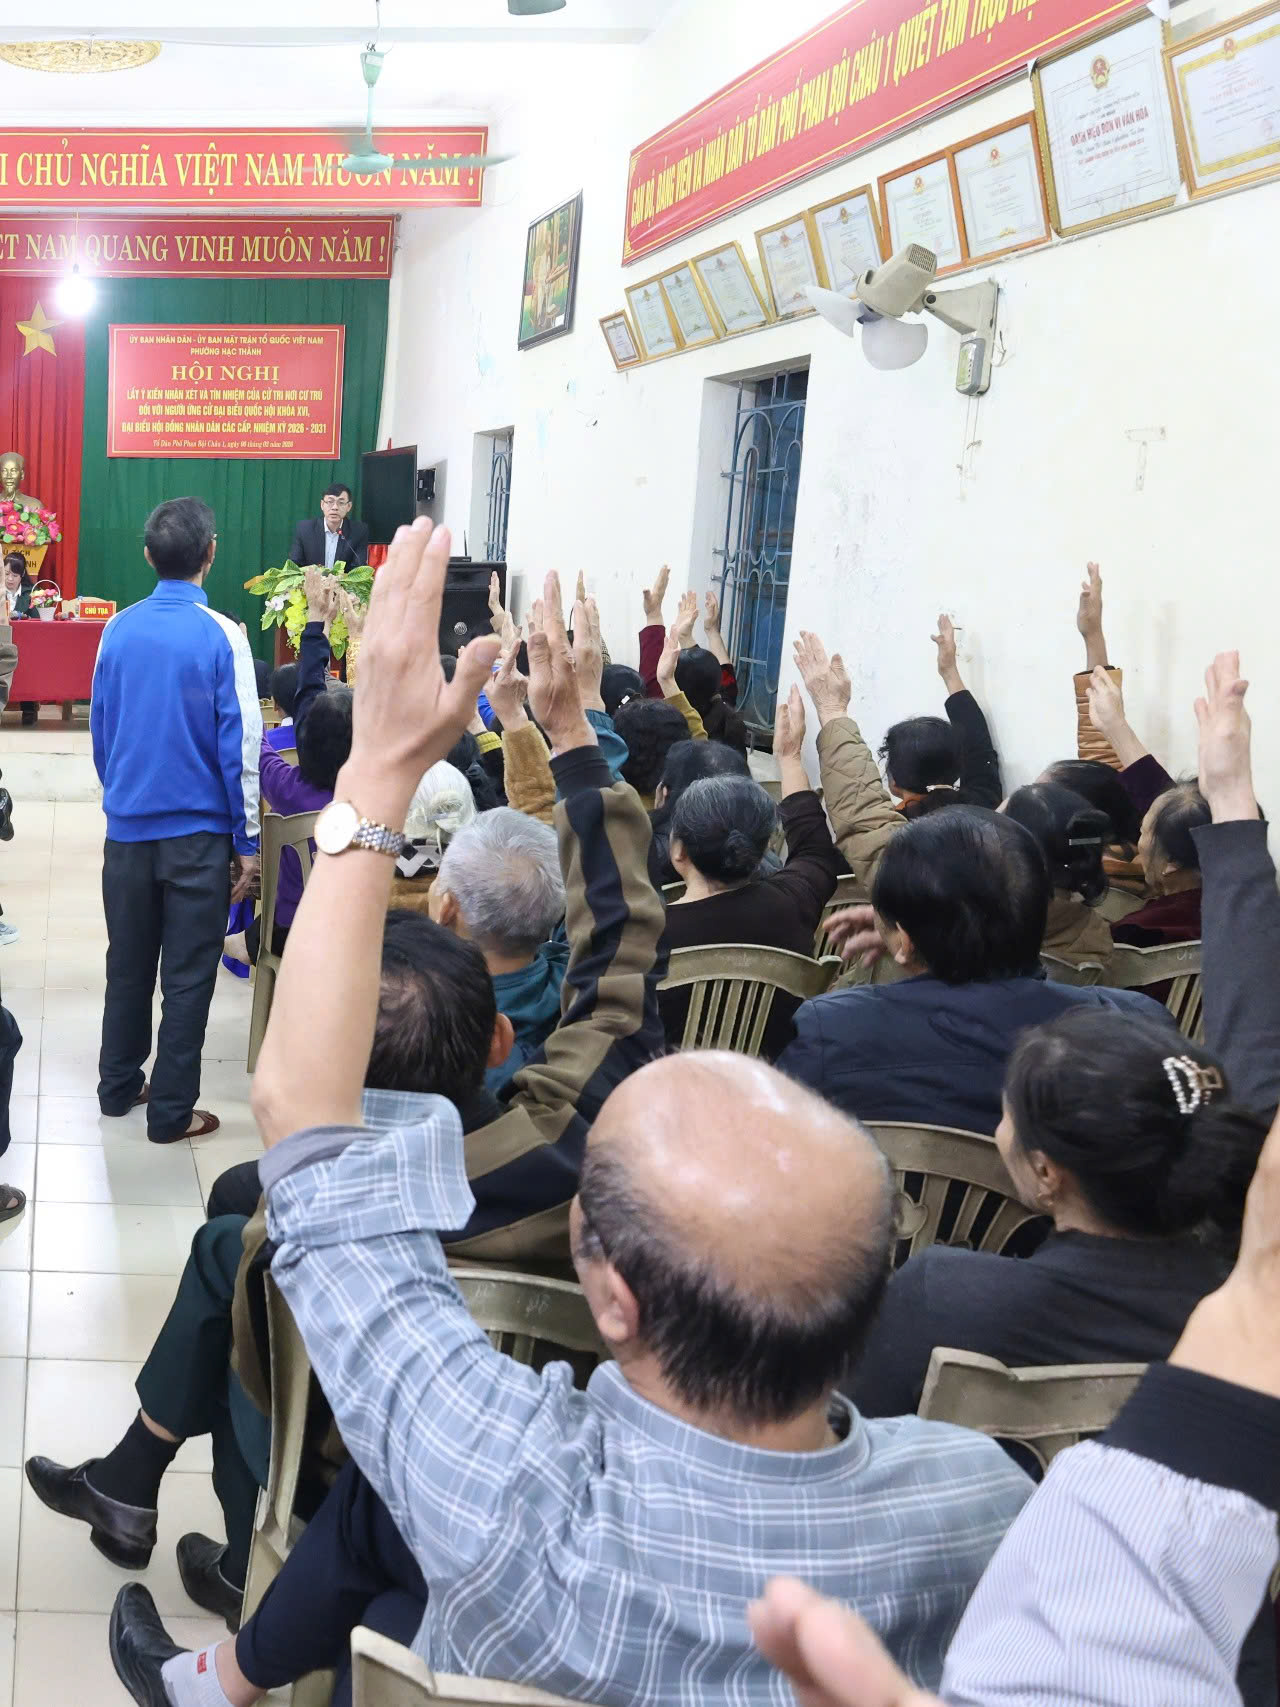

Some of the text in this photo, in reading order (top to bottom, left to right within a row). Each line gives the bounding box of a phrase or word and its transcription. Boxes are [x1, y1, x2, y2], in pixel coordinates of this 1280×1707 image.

[799, 68, 830, 134] PHAN
[828, 47, 851, 126] BỘI
[849, 29, 885, 106] CHÂU
[883, 31, 894, 88] 1
[16, 138, 73, 187] CHỦ
[80, 144, 168, 187] NGHĨA
[174, 142, 238, 196] VIỆT
[244, 153, 304, 187] NAM
[400, 143, 462, 187] NĂM
[26, 233, 77, 261] NAM
[84, 235, 169, 266] QUANG
[174, 235, 234, 262] VINH
[241, 228, 313, 263] MUÔN
[318, 228, 374, 263] NĂM
[140, 336, 154, 344] BAN
[156, 334, 176, 344] NHÂN
[177, 334, 192, 344] DÂN
[208, 336, 222, 344] BAN
[224, 335, 238, 346] MẶT
[240, 335, 257, 346] TRẬN
[259, 333, 268, 344] TỔ
[269, 334, 290, 344] QUỐC
[292, 335, 307, 346] VIỆT
[308, 336, 324, 344] NAM
[191, 346, 262, 357] PHƯỜNG HẠC THÀNH
[171, 360, 280, 385] HỘI NGHỊ
[127, 386, 140, 400] LẤY
[147, 387, 163, 400] KIẾN
[164, 388, 184, 402] NHẬN
[185, 388, 198, 400] XÉT
[199, 388, 208, 400] VÀ
[210, 388, 221, 400] TÍN
[223, 388, 245, 401] NHIỆM
[246, 387, 260, 400] CỦA
[262, 387, 273, 400] CỬ
[273, 390, 284, 400] TRI
[285, 389, 297, 400] NƠI
[299, 389, 309, 400] CƯ
[310, 388, 323, 400] TRÚ
[138, 402, 151, 416] ĐỐI
[152, 403, 163, 416] VỚI
[164, 403, 186, 416] NGƯỜI
[187, 403, 202, 416] ỨNG
[203, 402, 213, 416] CỬ
[213, 405, 225, 418] ĐẠI
[227, 401, 243, 416] BIỂU
[244, 402, 263, 417] QUỐC
[264, 404, 275, 418] HỘI
[276, 404, 296, 416] KHÓA
[152, 420, 164, 435] HỘI
[165, 419, 184, 433] ĐỒNG
[185, 421, 205, 433] NHÂN
[206, 421, 221, 433] DÂN
[221, 421, 236, 433] CÁC
[253, 421, 276, 435] NHIỆM
[287, 423, 305, 433] 2026
[310, 423, 327, 433] 2031
